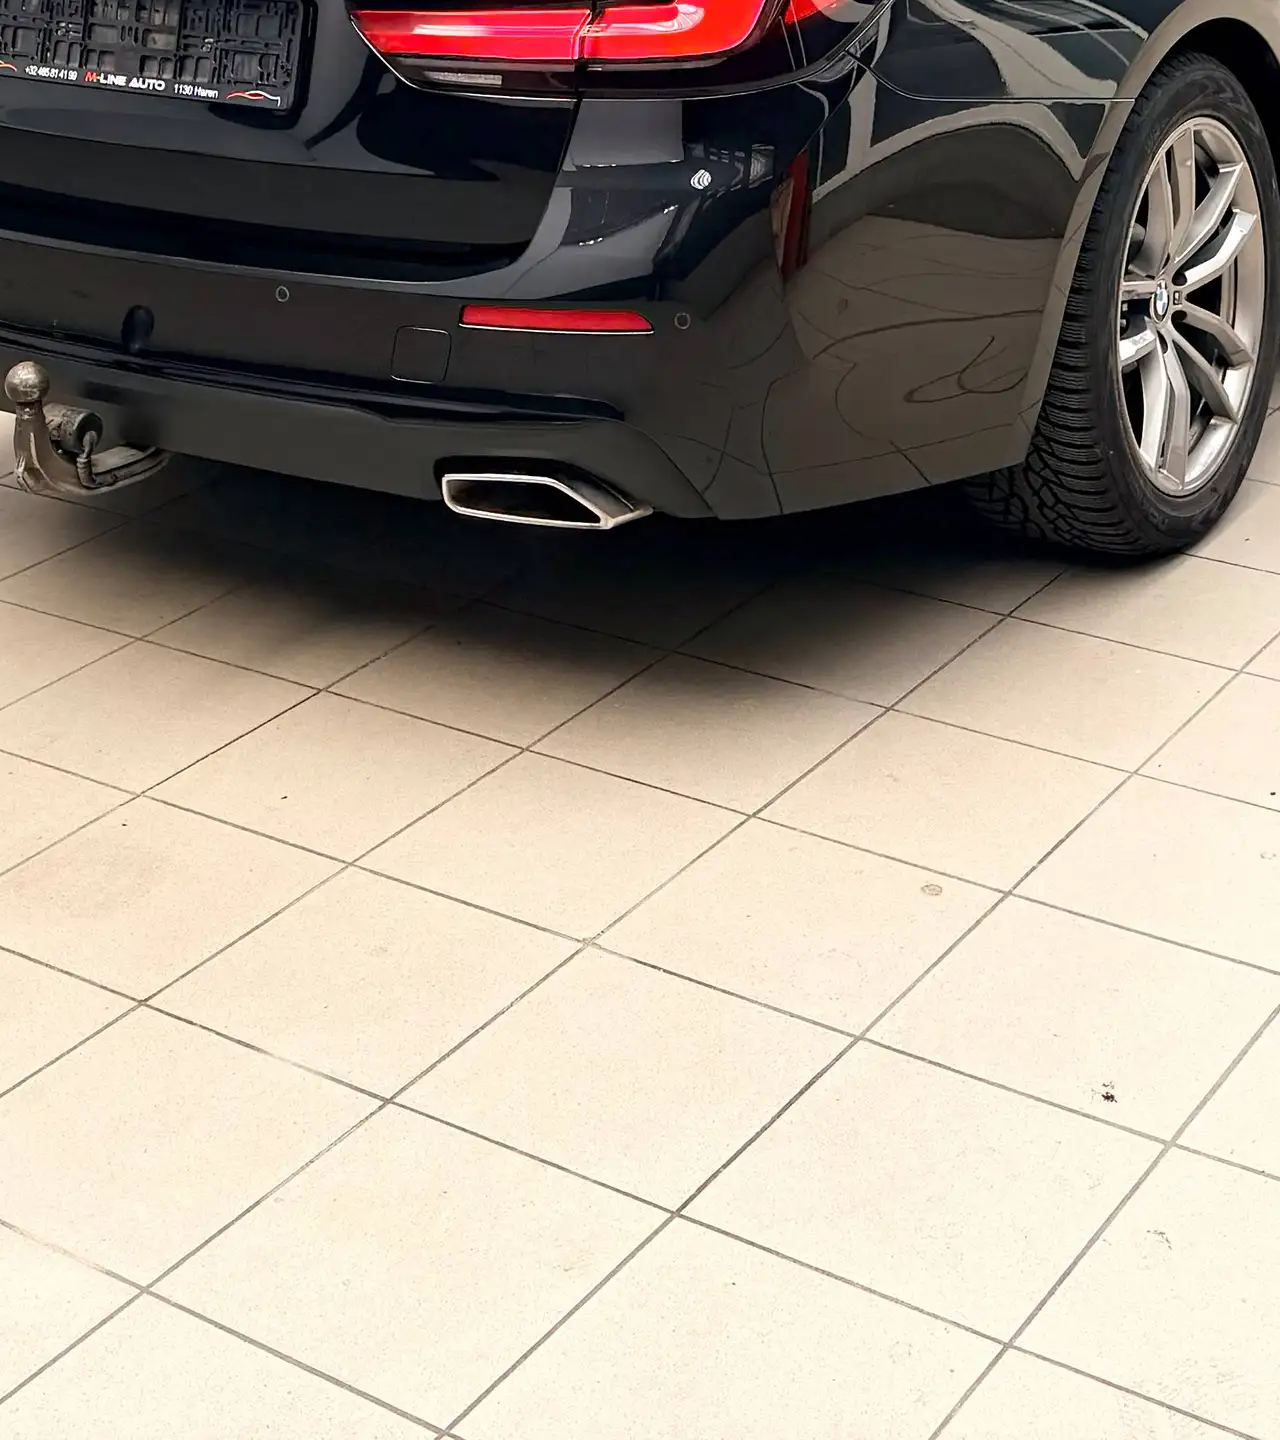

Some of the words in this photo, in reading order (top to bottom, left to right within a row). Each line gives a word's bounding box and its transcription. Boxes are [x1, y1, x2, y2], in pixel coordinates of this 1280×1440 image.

[84, 71, 127, 86] M-LINE
[129, 77, 166, 91] AUTO
[174, 83, 193, 95] 1130
[193, 86, 219, 99] Haren
